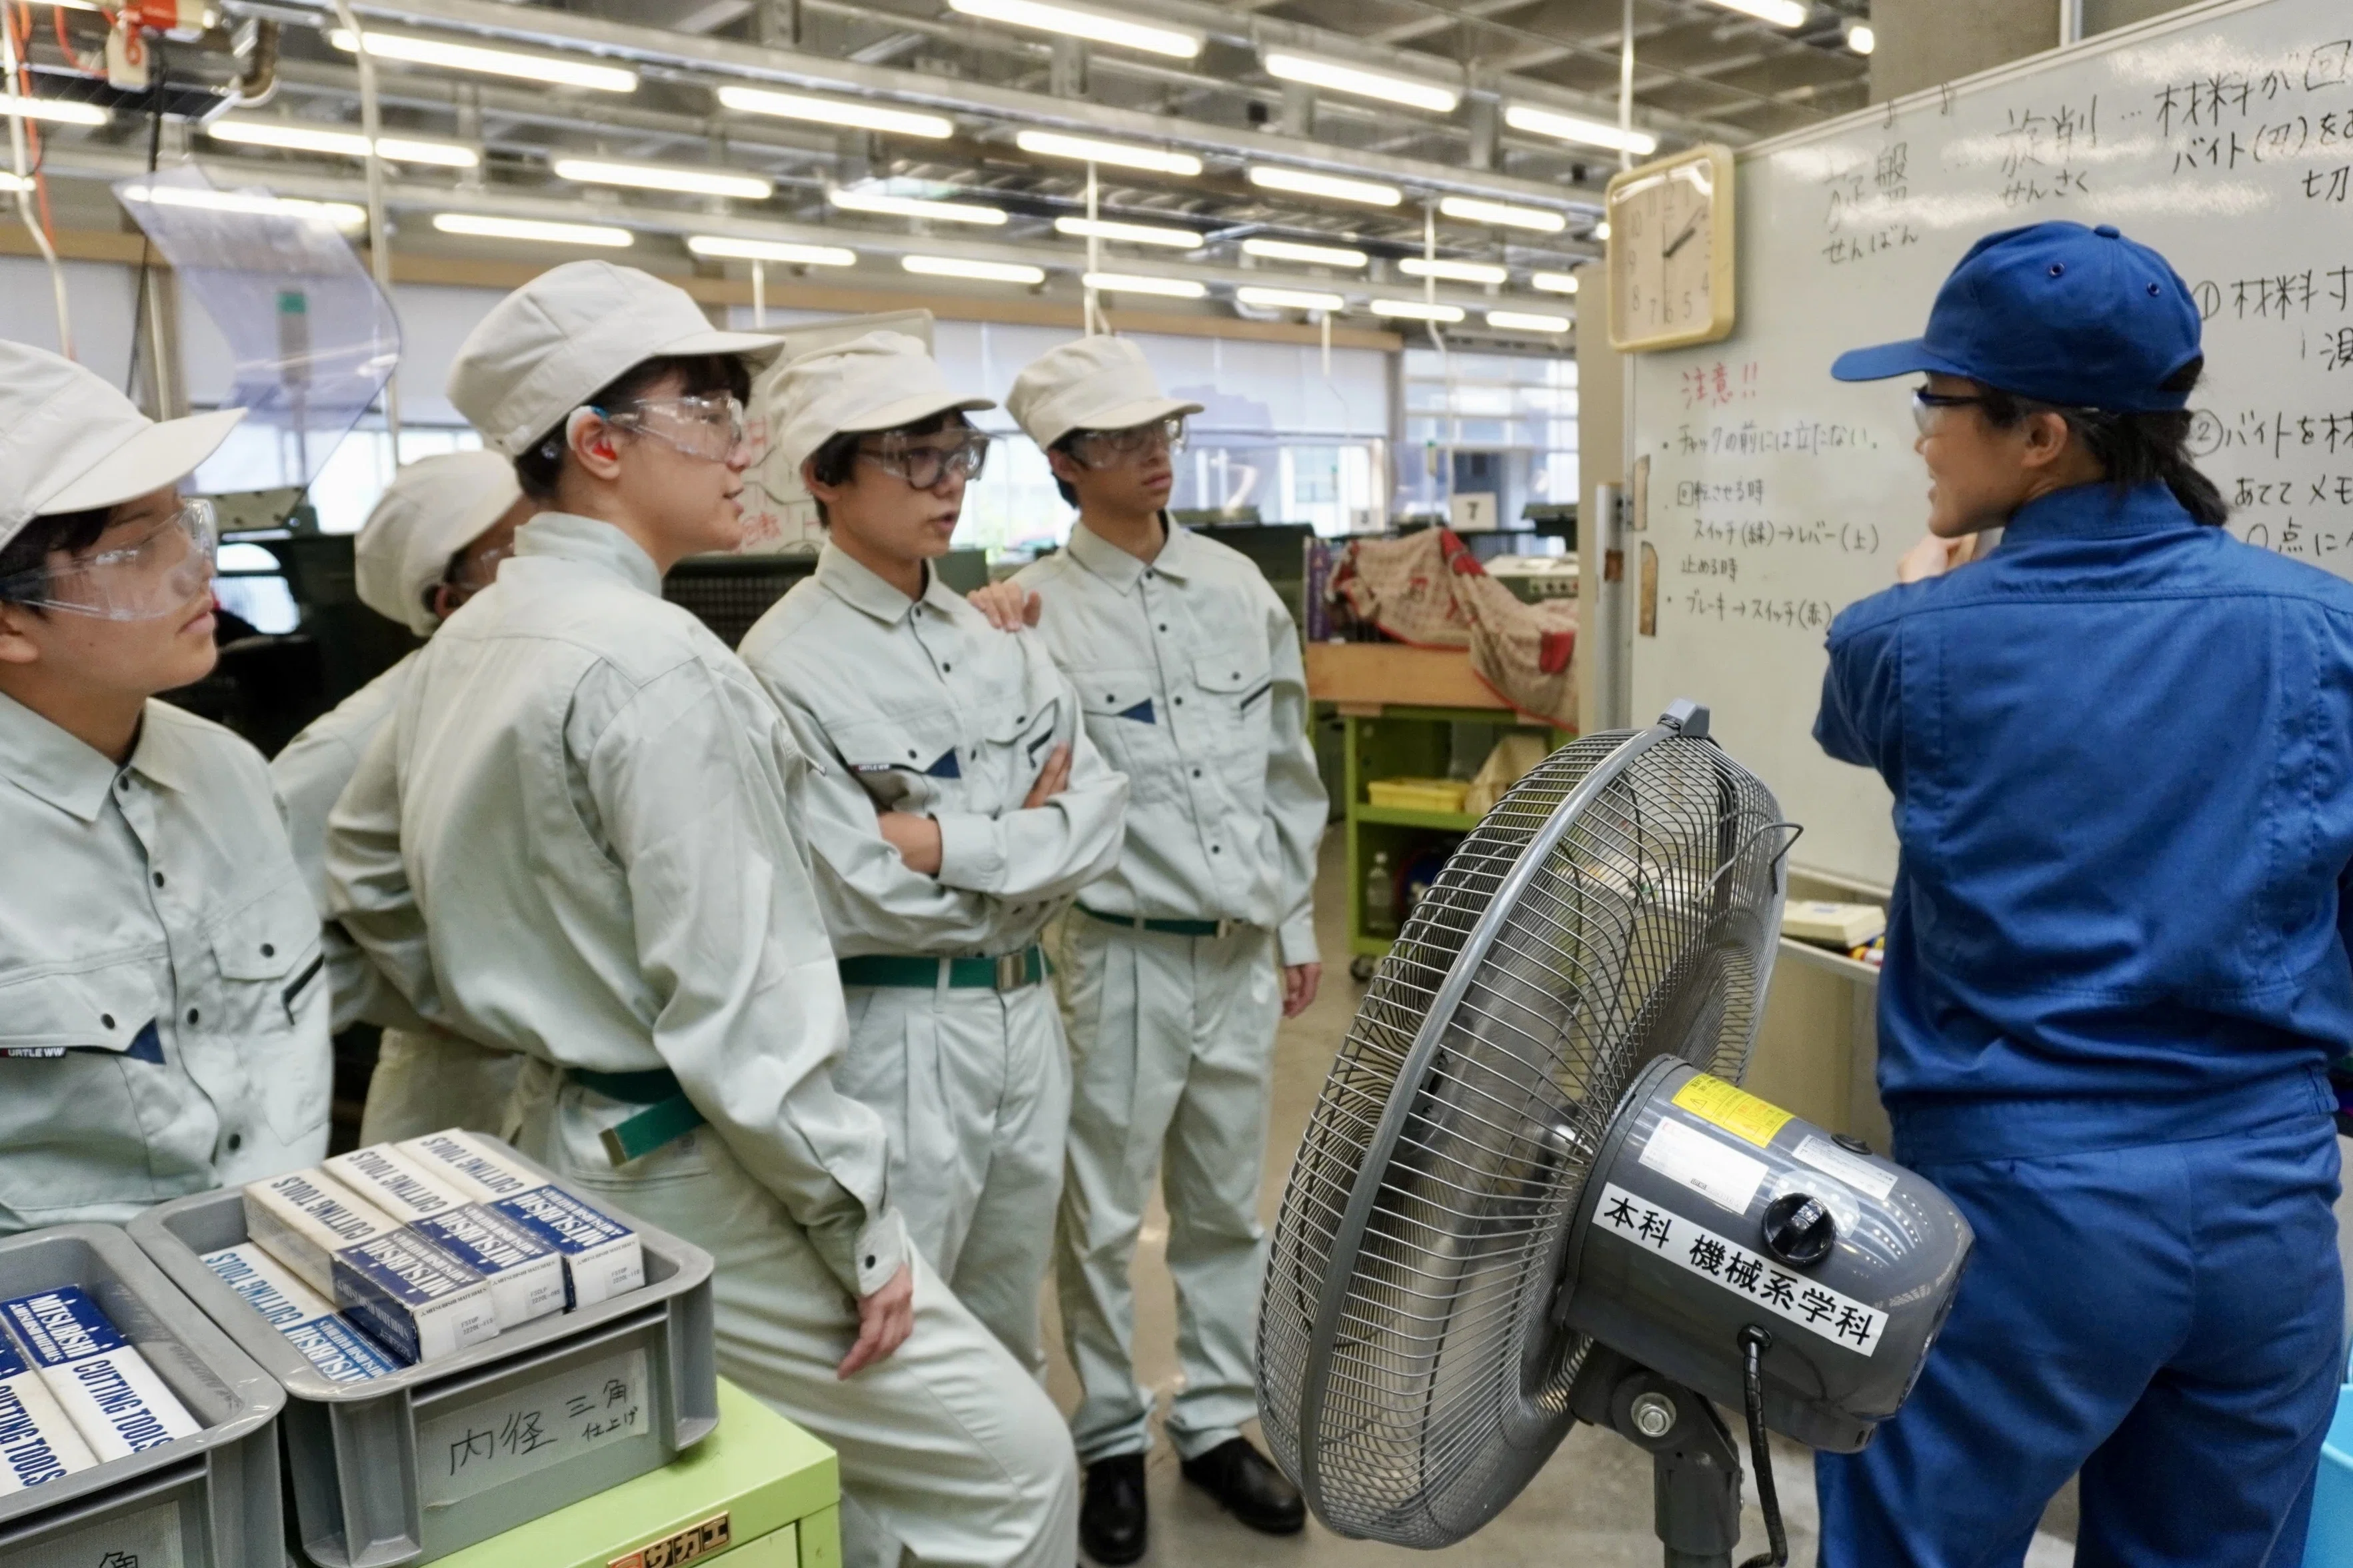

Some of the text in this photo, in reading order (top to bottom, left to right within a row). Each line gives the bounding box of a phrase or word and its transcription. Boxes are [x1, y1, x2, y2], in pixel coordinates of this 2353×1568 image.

[1822, 224, 1918, 263] せんばん
[1468, 501, 1478, 520] 7
[1681, 554, 1738, 582] 止める時
[44, 1048, 65, 1057] WW
[270, 1176, 325, 1207] TOOLS
[347, 1151, 448, 1212] CUTTING TOOLS
[420, 1136, 525, 1193] CUTTING TOOLS
[304, 1199, 376, 1240] CUTTING
[429, 1211, 528, 1267] MITSUBISHI
[509, 1193, 609, 1247] MITSUBISHI
[205, 1252, 304, 1325] CUTTING TOOLS
[355, 1238, 458, 1297] MITSUBISHI
[1604, 1197, 1871, 1347] 本科 機械系学科
[27, 1293, 103, 1359] MITSUBISHI
[73, 1359, 175, 1453] CUTTING TOOLS
[450, 1378, 629, 1476] 内径 三角
[582, 1405, 638, 1443] 仕上げ
[4, 1437, 67, 1487] TOOLS
[645, 1517, 728, 1568] サカエ
